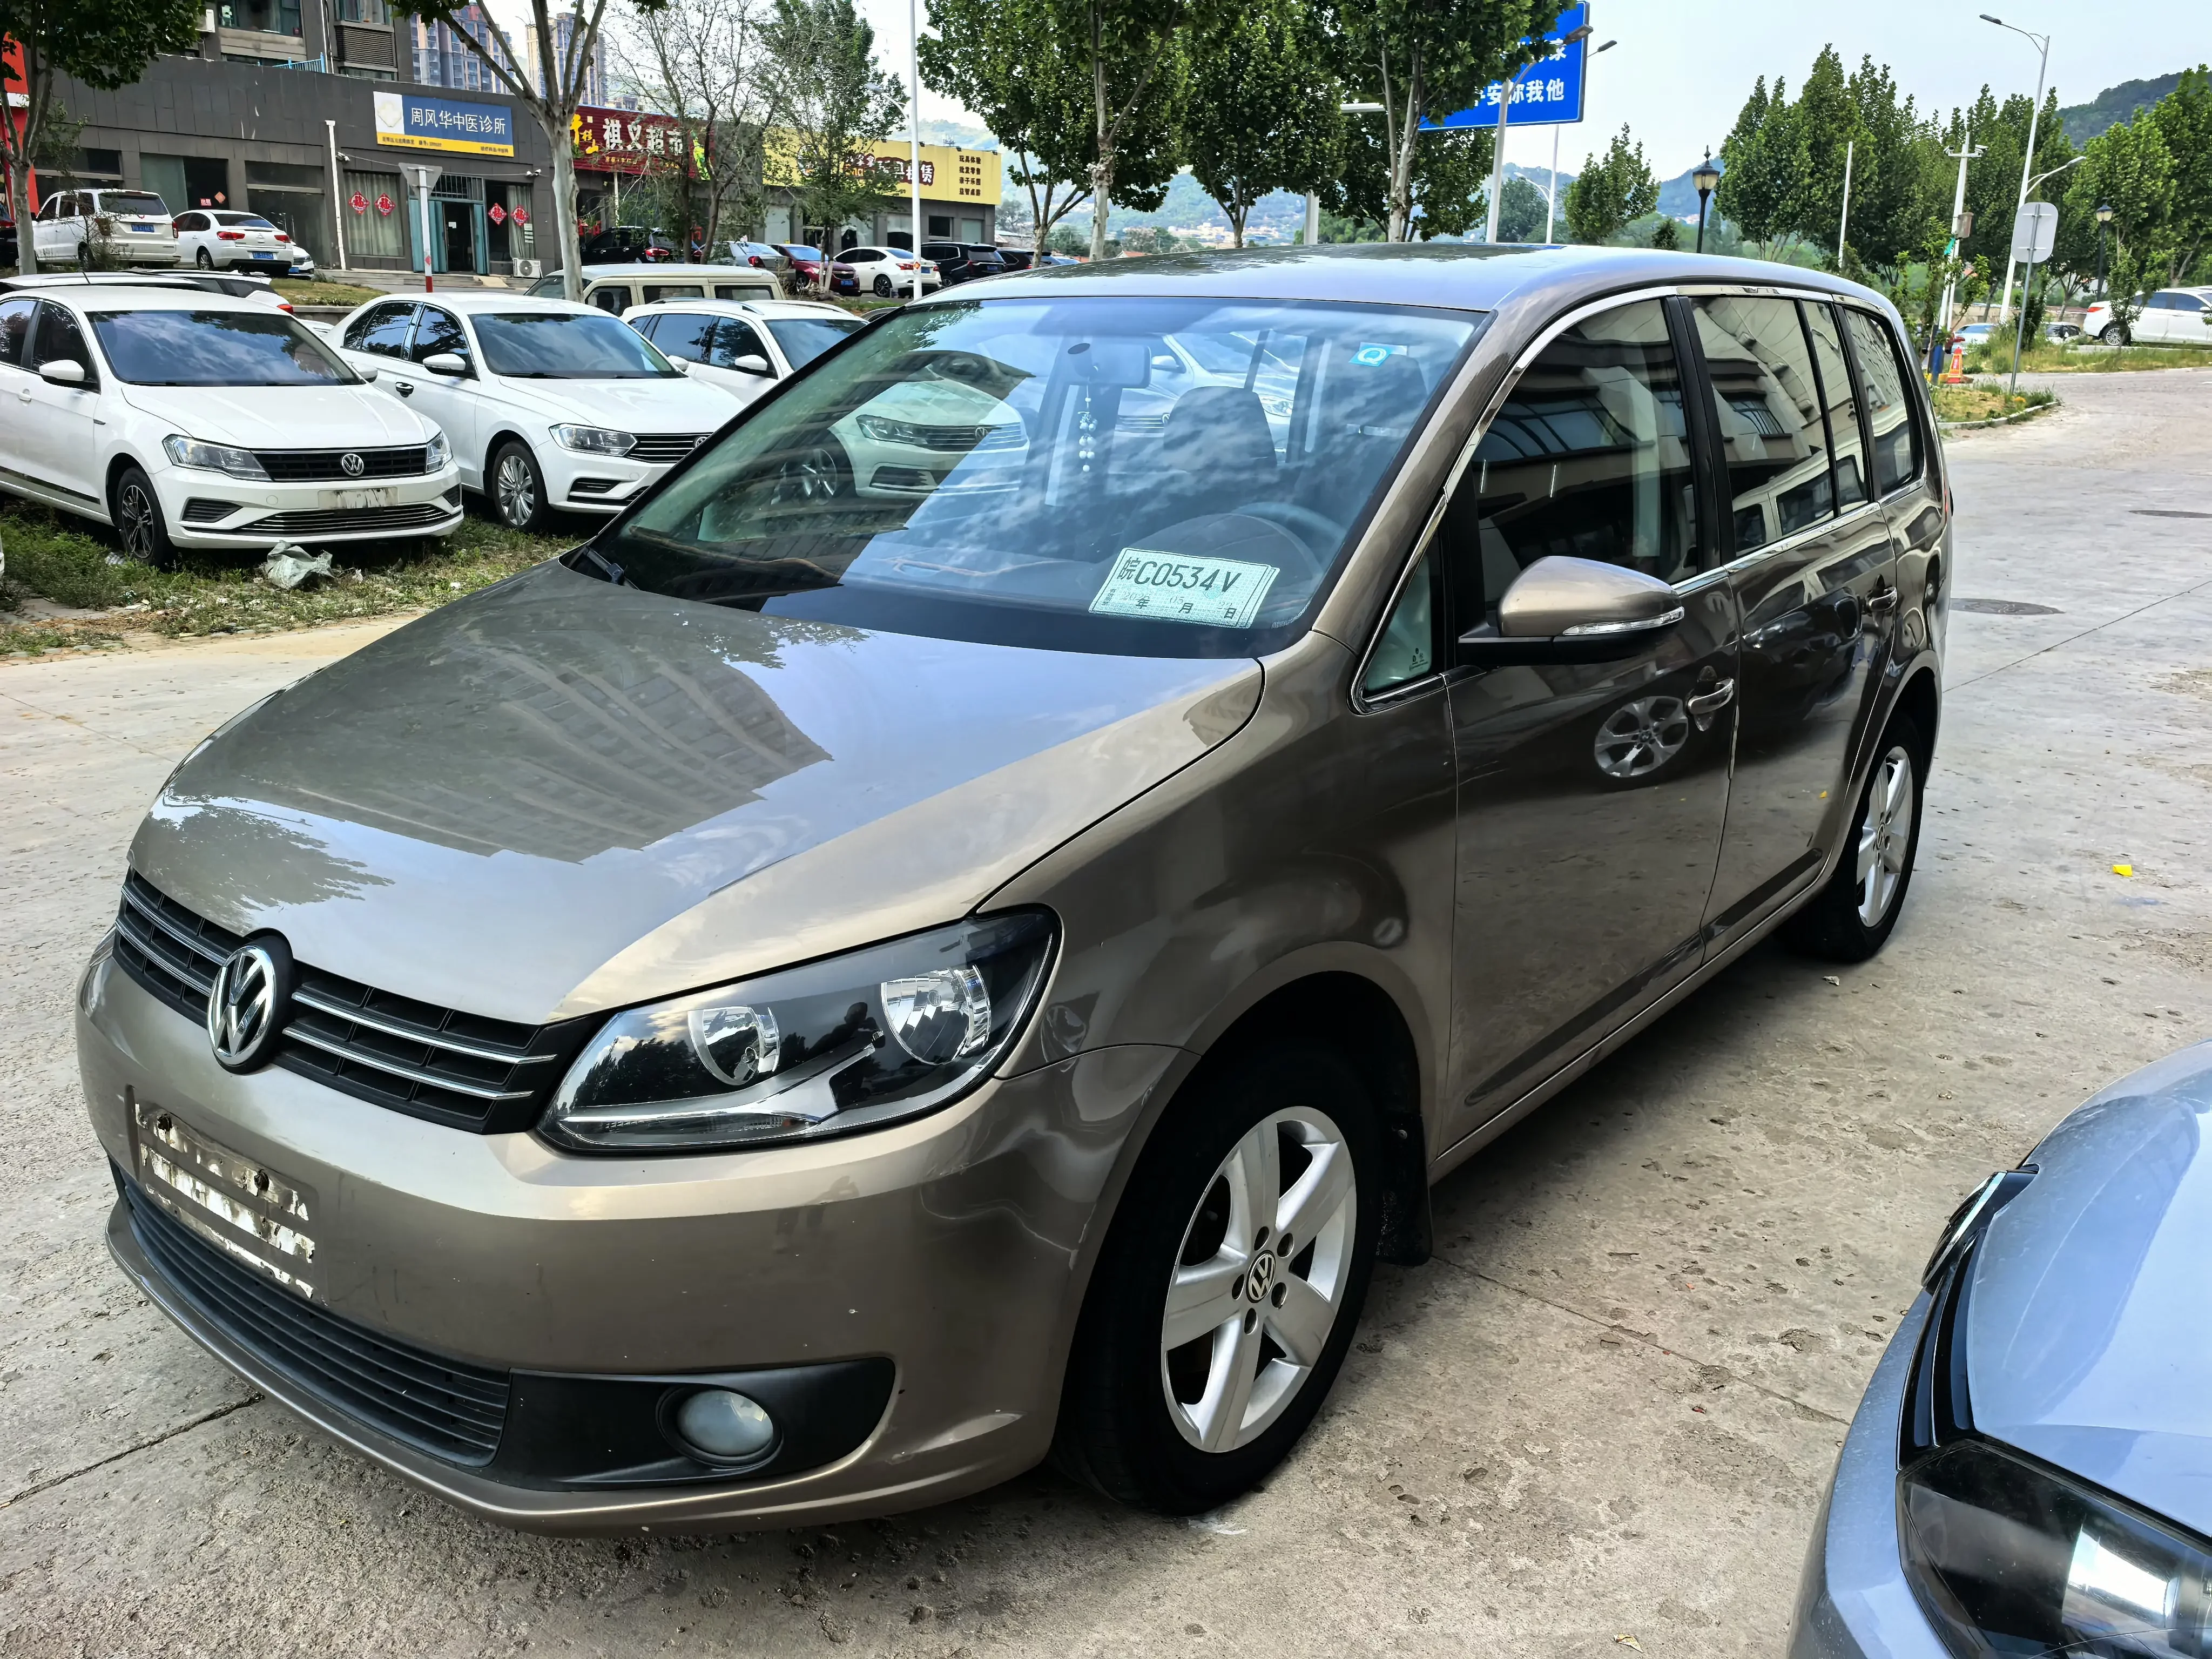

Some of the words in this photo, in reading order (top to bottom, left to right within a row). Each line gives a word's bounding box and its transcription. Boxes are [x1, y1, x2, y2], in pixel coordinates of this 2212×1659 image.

[411, 107, 505, 135] 周风华中医诊所
[1117, 557, 1242, 592] 皖C0534V
